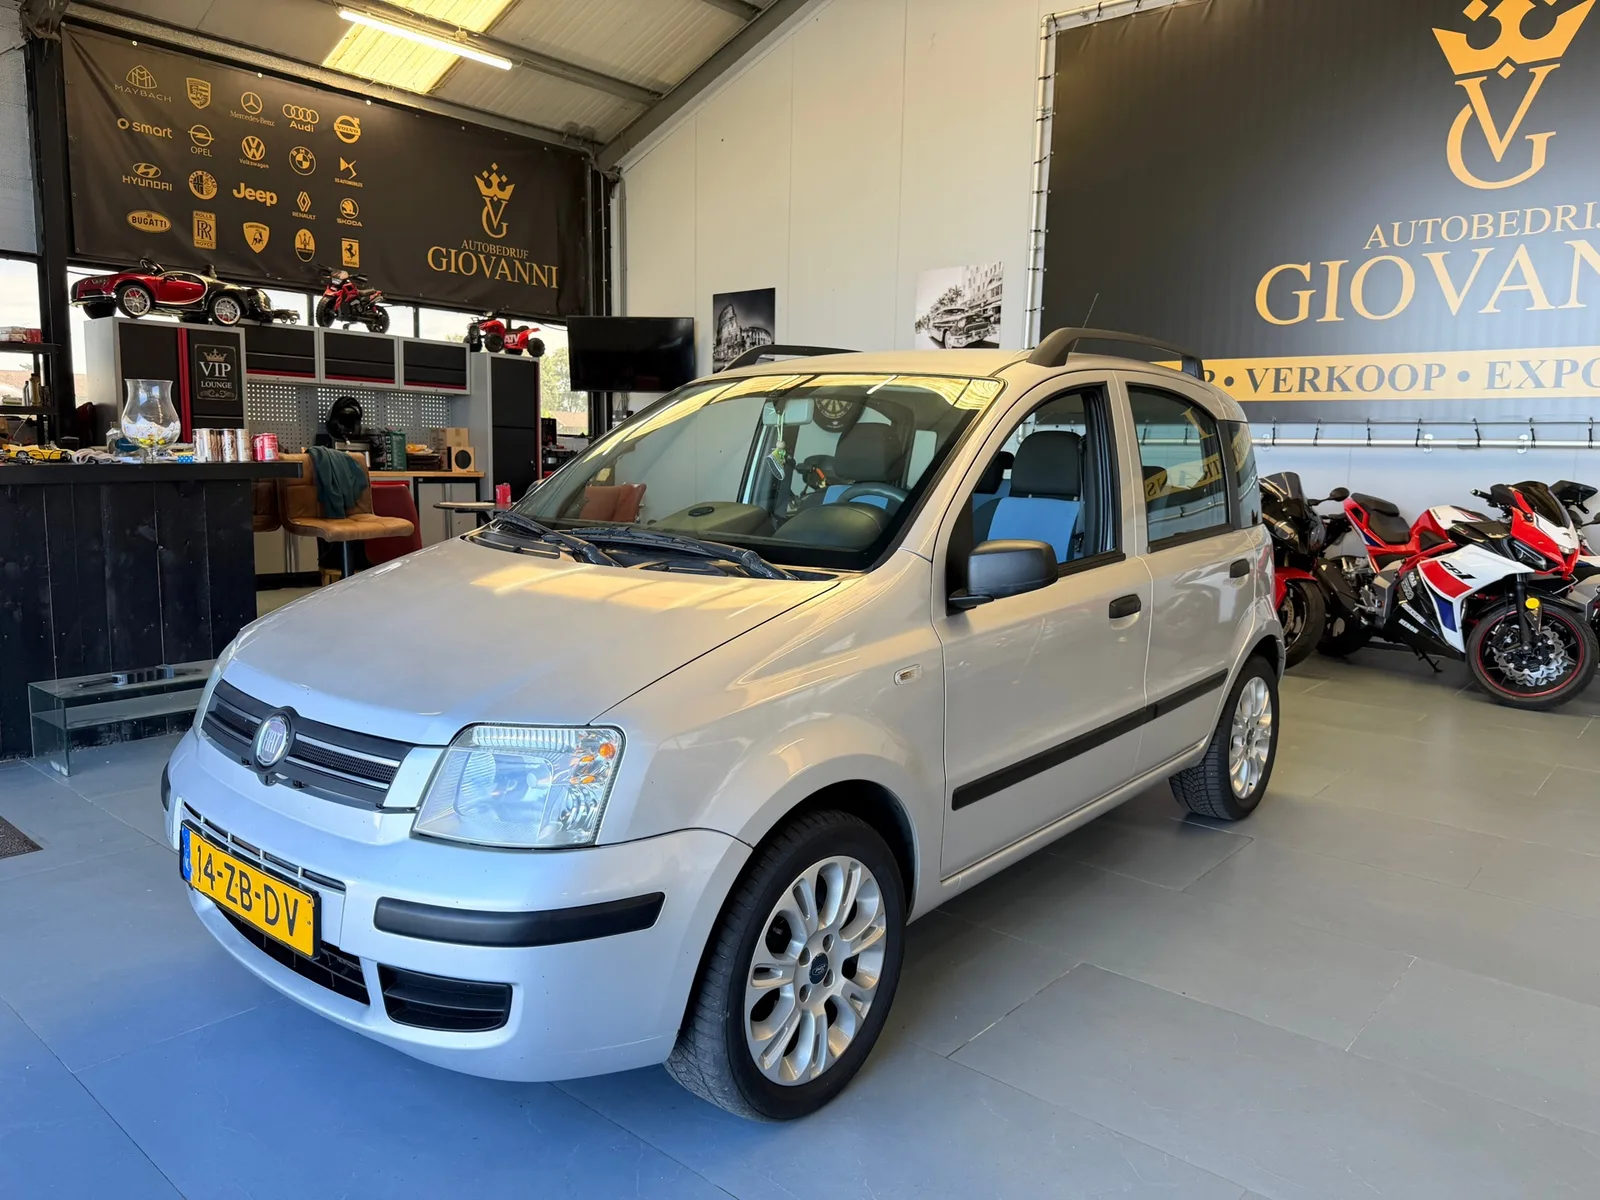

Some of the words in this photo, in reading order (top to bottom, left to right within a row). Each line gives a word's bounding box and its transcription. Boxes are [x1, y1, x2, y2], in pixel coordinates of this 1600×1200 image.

[114, 84, 172, 102] MAYBACH
[132, 121, 173, 139] smart
[289, 120, 314, 132] Audi
[336, 125, 359, 134] VOLVO
[190, 146, 213, 157] OPEL
[239, 158, 270, 169] Volkswagen
[122, 175, 172, 191] HYUNDAI
[232, 182, 278, 206] Jeep
[131, 216, 167, 228] BUGATTI
[292, 211, 316, 220] RENAULT
[1363, 201, 1600, 250] AUTOBEDRI
[461, 239, 529, 260] AUTOBEDRIJF
[427, 246, 559, 289] GIOVANNI
[199, 361, 232, 378] VIP
[200, 381, 232, 389] LOUNGE
[1245, 363, 1447, 394] VERKOOP
[197, 845, 299, 937] 14-ZB-DV
